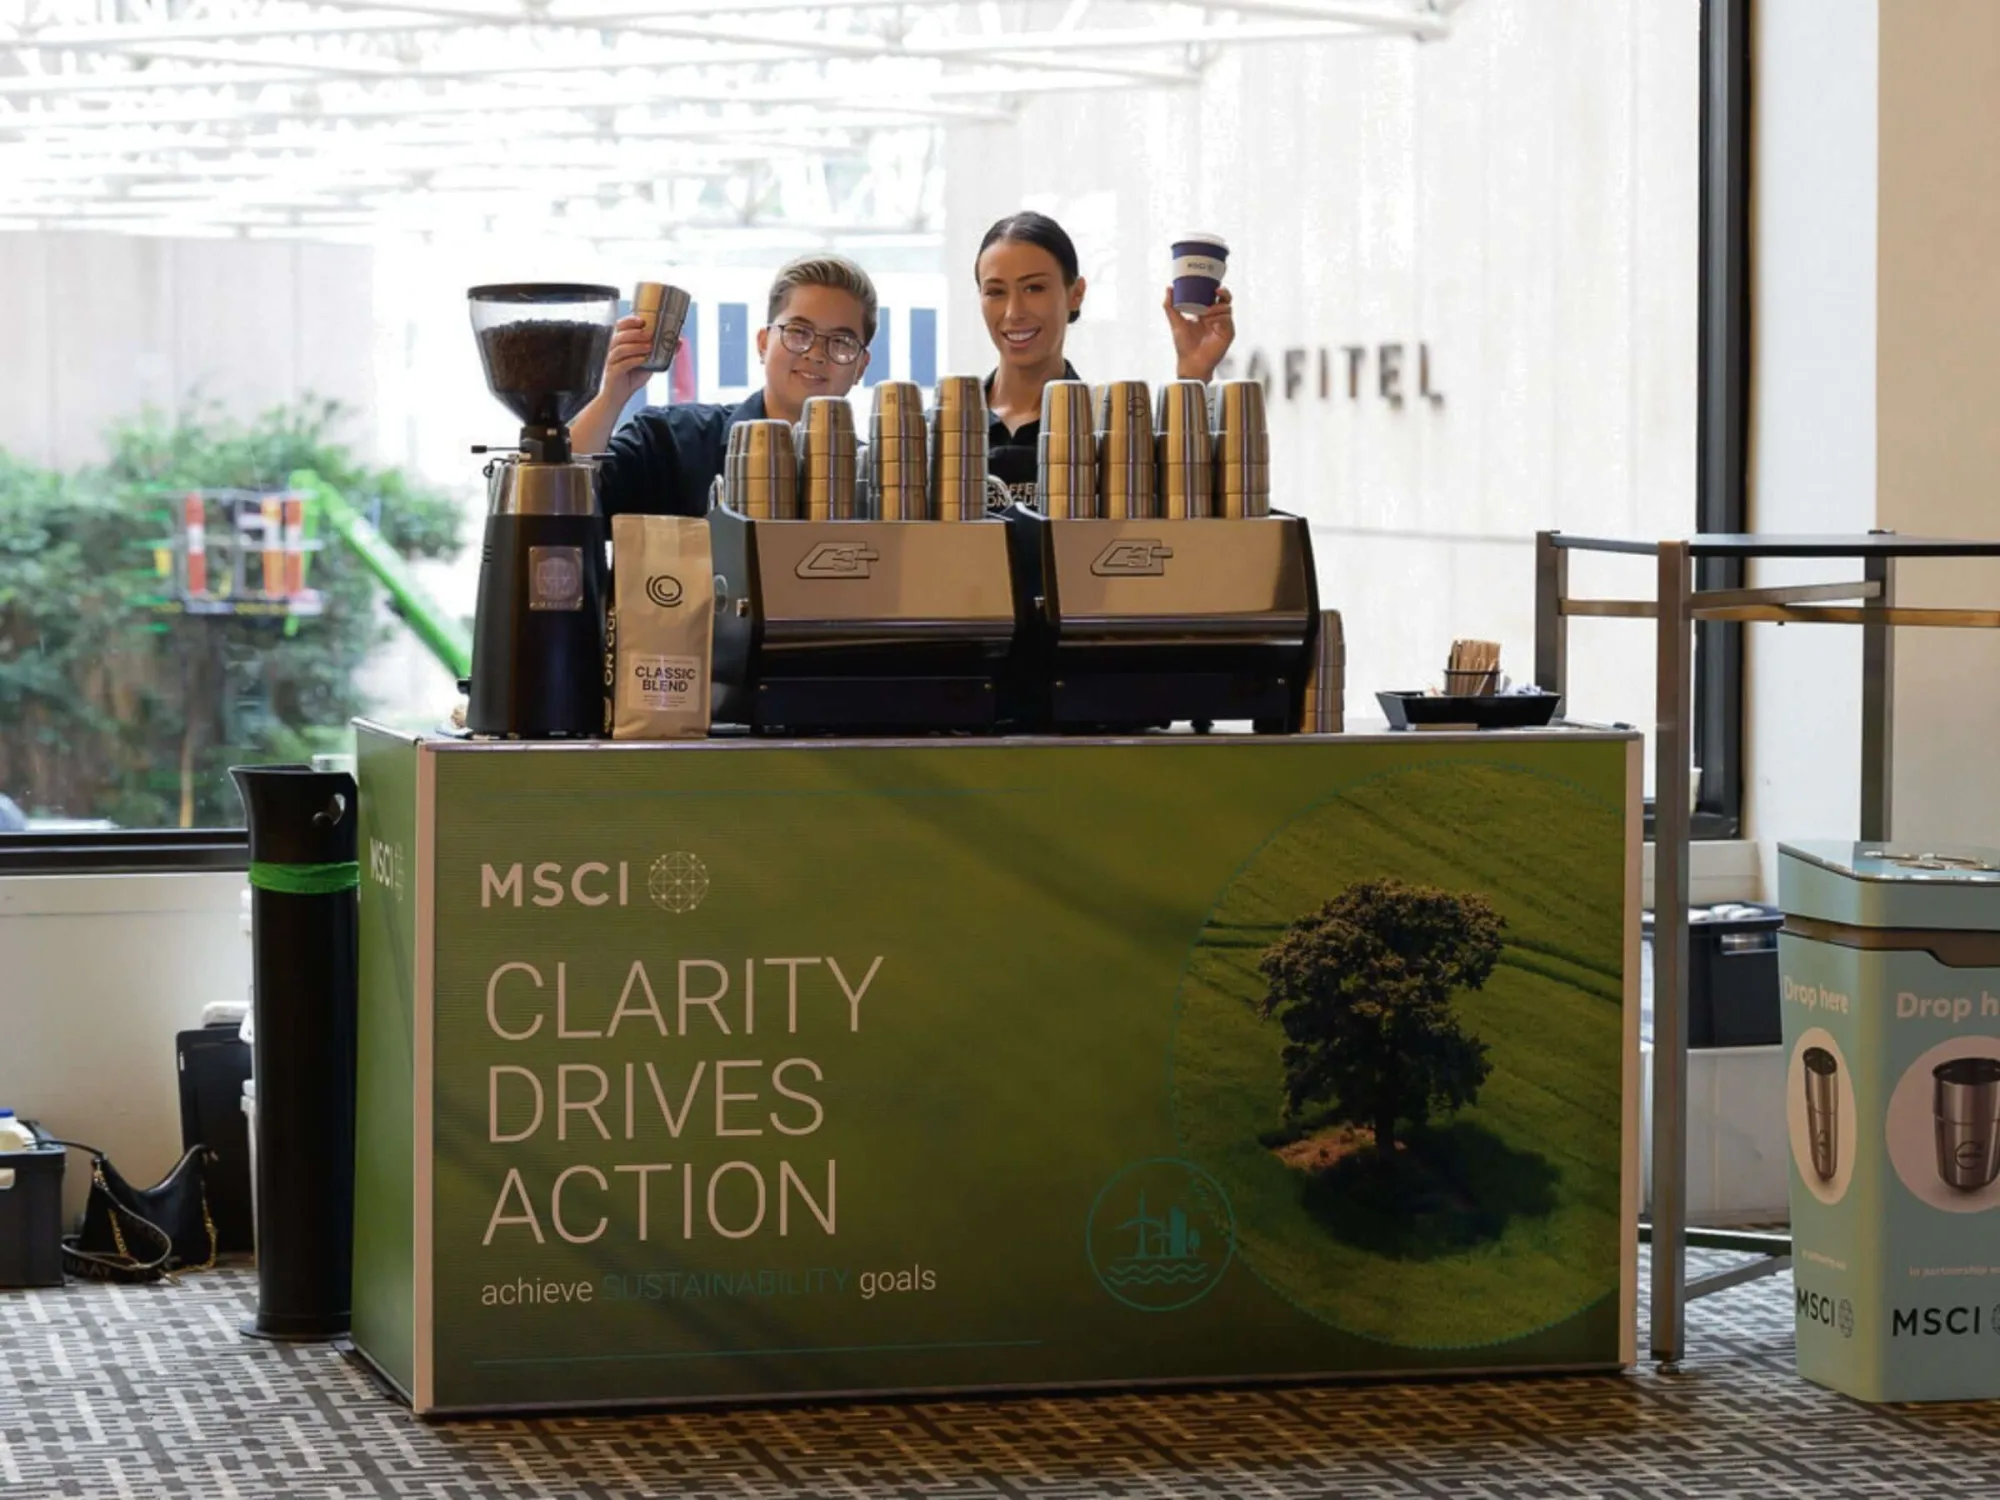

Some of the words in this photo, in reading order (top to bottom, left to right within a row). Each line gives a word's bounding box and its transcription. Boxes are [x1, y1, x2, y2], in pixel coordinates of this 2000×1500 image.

[1216, 343, 1442, 408] OFITEL
[634, 665, 696, 680] CLASSIC
[642, 679, 689, 693] BLEND
[370, 836, 394, 889] MSCI
[480, 861, 629, 908] MSCI
[485, 955, 884, 1041] CLARITY
[1783, 975, 1817, 1013] Drop
[1819, 983, 1849, 1014] here
[1896, 991, 1973, 1023] Drop
[488, 1058, 825, 1144] DRIVES
[482, 1158, 837, 1246] ACTION
[481, 1277, 594, 1305] achieve
[602, 1267, 852, 1300] SUSTAINABILITY
[858, 1264, 937, 1299] goals
[1796, 1286, 1836, 1328] MSCI
[1891, 1305, 1981, 1337] MSCI
